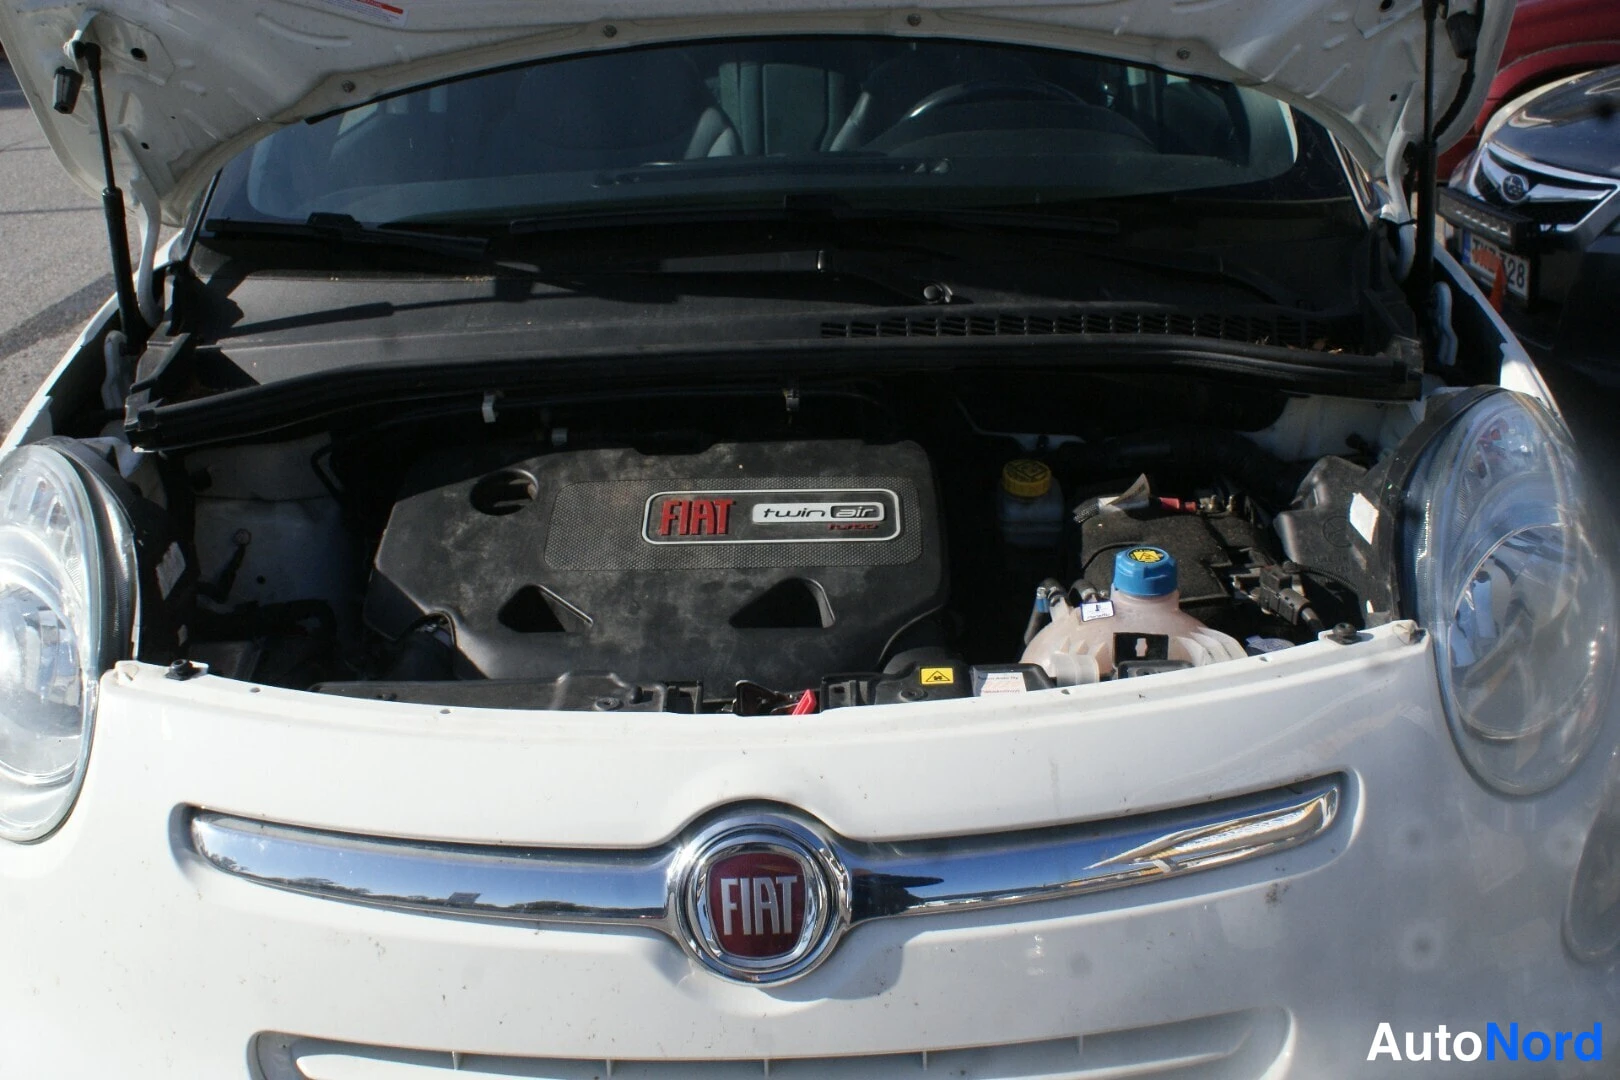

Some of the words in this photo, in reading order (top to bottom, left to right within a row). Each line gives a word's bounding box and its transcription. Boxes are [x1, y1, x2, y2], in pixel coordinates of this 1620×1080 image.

[659, 499, 735, 536] FIAT
[763, 507, 826, 518] twin
[835, 506, 875, 518] air
[720, 875, 798, 936] FIAT
